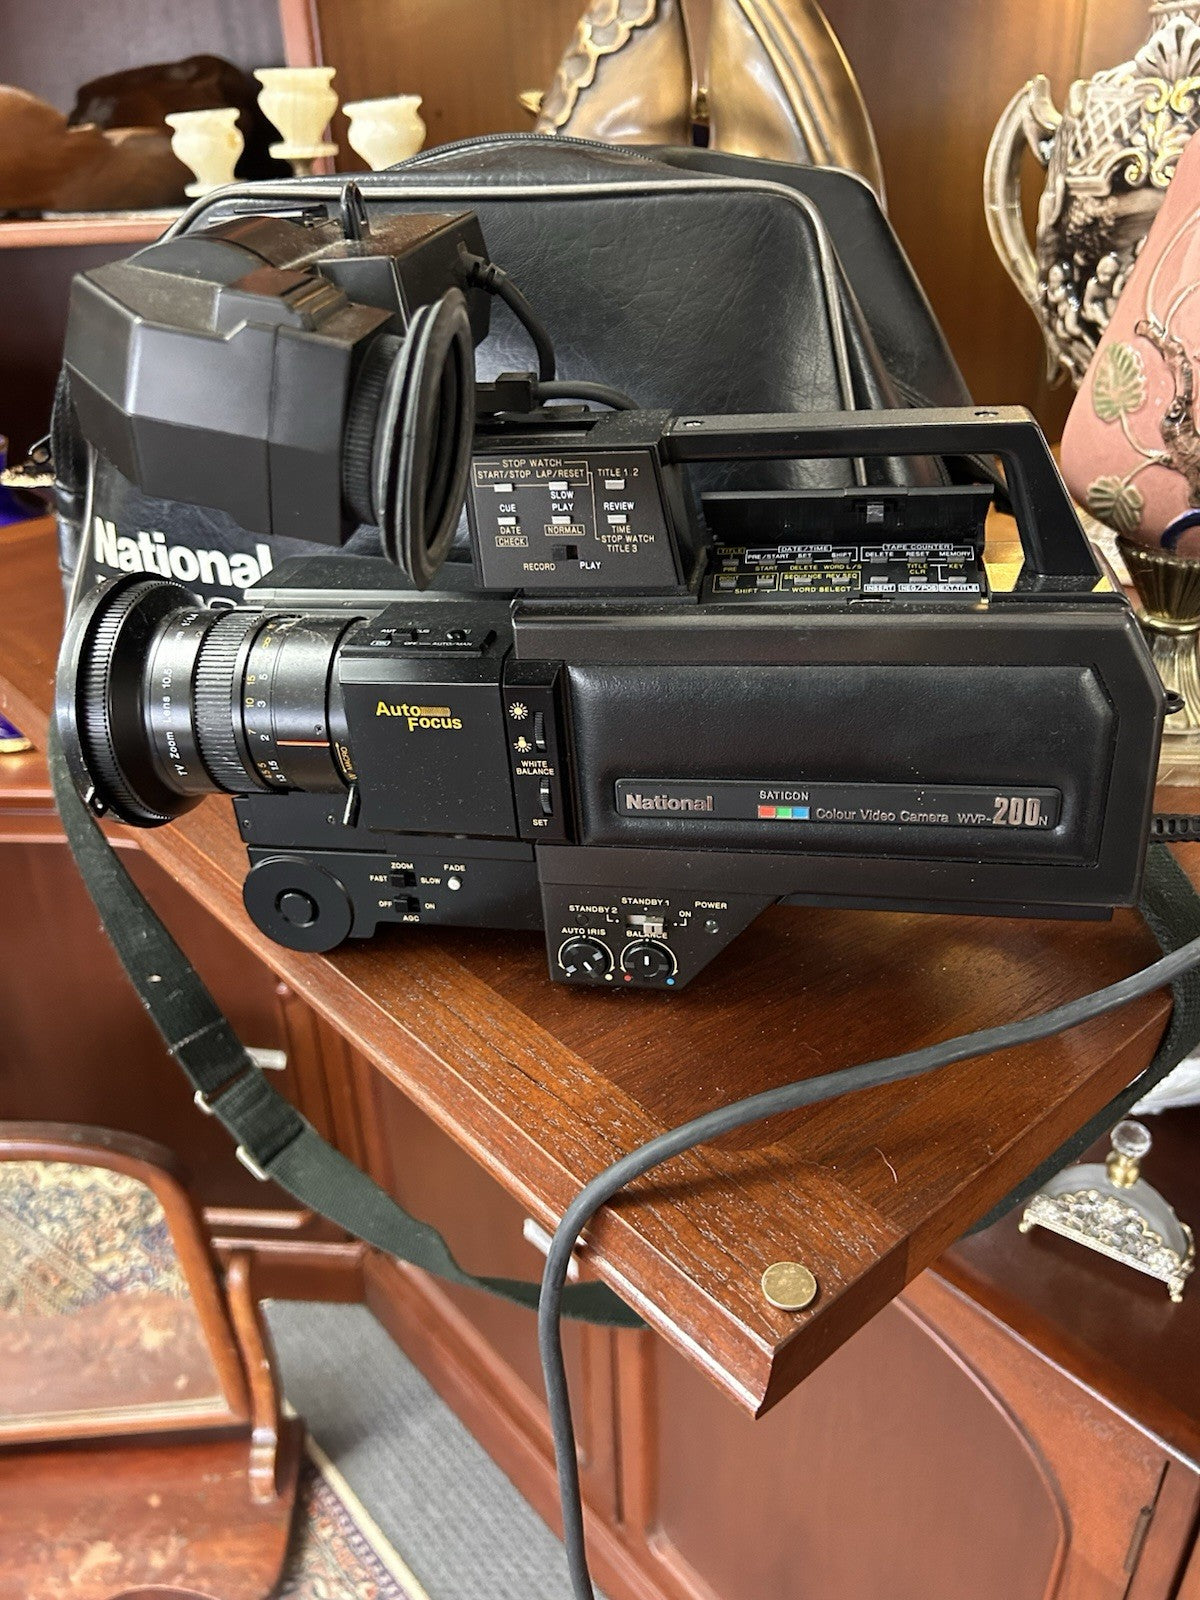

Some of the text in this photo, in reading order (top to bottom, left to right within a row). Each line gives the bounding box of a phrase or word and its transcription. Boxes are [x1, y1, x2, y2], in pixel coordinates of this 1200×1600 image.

[502, 458, 562, 467] STOP WATCH
[477, 469, 585, 479] START/STOP LAP/RESET
[598, 468, 620, 477] TITLE
[550, 491, 574, 500] SLOW
[499, 504, 516, 513] CUE
[551, 503, 574, 511] PLAY
[603, 502, 635, 511] REVIEW
[500, 526, 521, 535] DATE
[547, 526, 582, 535] NORMAL
[611, 525, 631, 533] TIME
[498, 537, 526, 546] CHECK
[601, 534, 655, 544] STOP WATCH
[93, 515, 273, 589] National
[607, 544, 638, 553] TITLE 3
[781, 545, 828, 553] DATE/TIME
[523, 562, 556, 571] RECORD
[579, 561, 601, 570] PLAY
[245, 697, 254, 708] 10
[257, 700, 266, 708] 3
[163, 696, 171, 723] Lens
[376, 701, 421, 717] Auto
[407, 717, 463, 732] Focus
[166, 731, 180, 759] Zoom
[520, 760, 548, 768] WHITE
[175, 764, 188, 776] TV
[516, 767, 555, 776] BALANCE
[759, 790, 809, 801] SATICON
[626, 793, 714, 811] National
[816, 807, 856, 821] Colour
[860, 808, 896, 822] Video
[900, 810, 949, 823] Camera
[532, 819, 548, 827] SET
[391, 862, 414, 870] ZOOM
[443, 864, 466, 872] FADE
[369, 874, 388, 882] FAST
[420, 876, 441, 885] SLOW
[378, 900, 392, 908] OFF
[424, 902, 436, 910] ON
[621, 897, 663, 906] STANDBY
[694, 901, 727, 910] POWER
[569, 905, 618, 914] STANDBY 2
[679, 910, 692, 918] ON
[561, 927, 606, 936] AUTO IRIS
